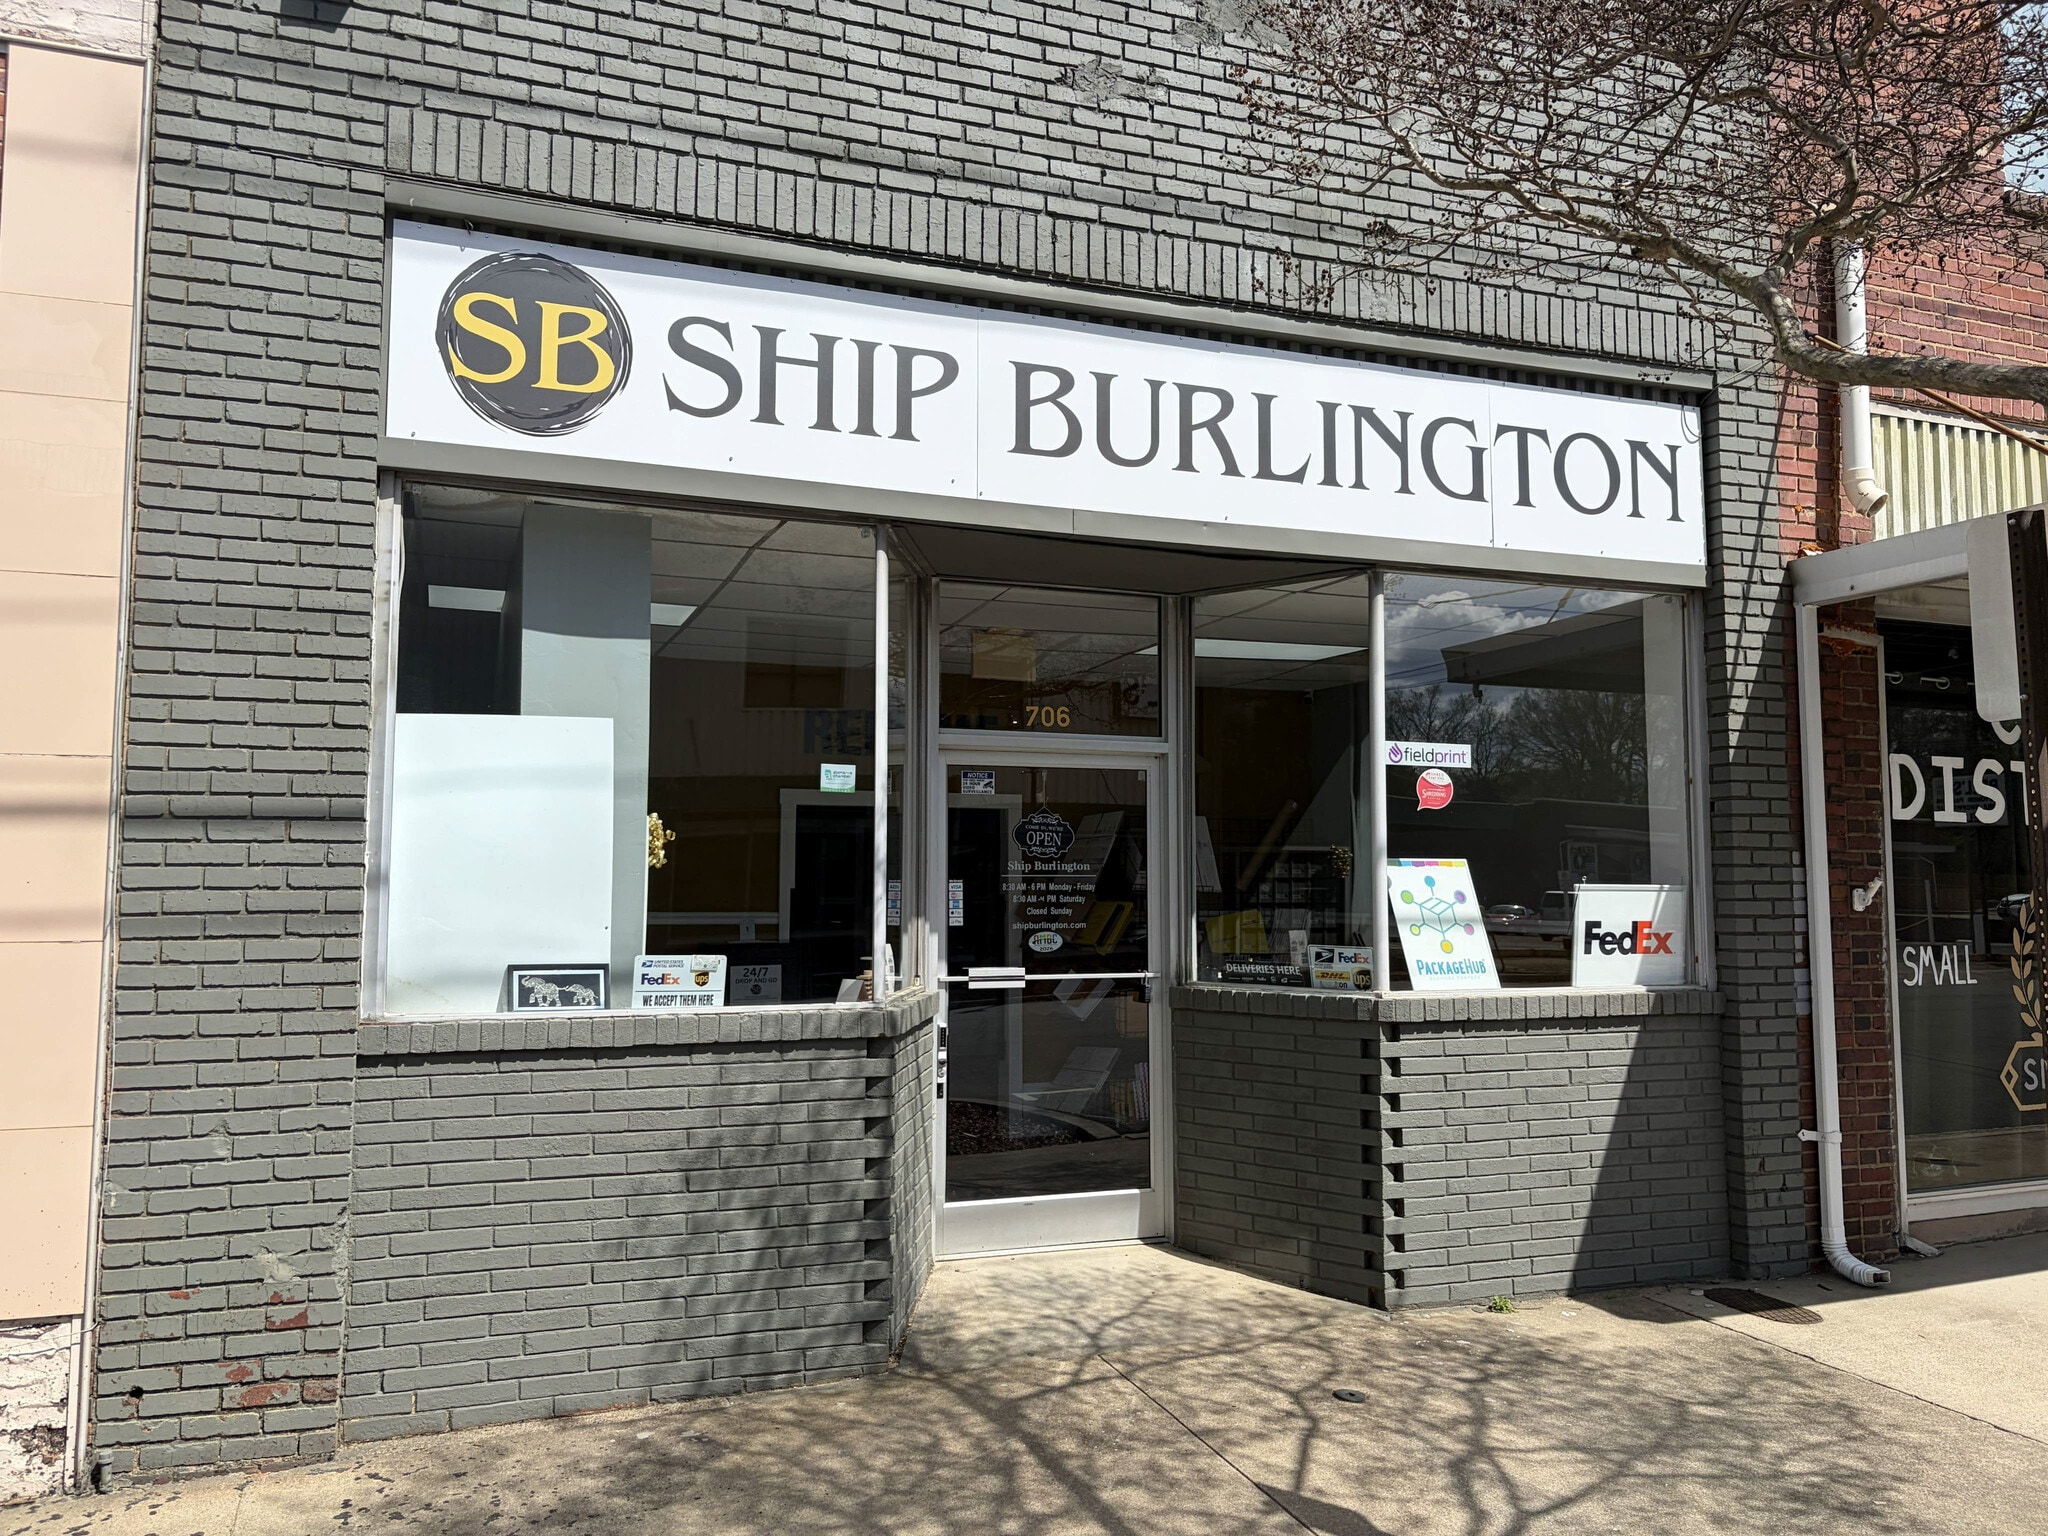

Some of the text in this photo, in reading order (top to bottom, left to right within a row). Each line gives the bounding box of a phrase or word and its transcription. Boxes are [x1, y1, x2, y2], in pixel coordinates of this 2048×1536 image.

[449, 291, 616, 394] SB
[662, 315, 1685, 523] SHIP BURLINGTON
[1026, 705, 1071, 728] 706
[1403, 746, 1467, 766] fieldprint
[1026, 830, 1062, 847] OPEN
[1007, 860, 1091, 873] Ship Burlington
[1002, 882, 1015, 891] 8:30
[1016, 883, 1027, 891] AM
[1031, 883, 1036, 891] 6
[1036, 883, 1046, 891] PM
[1048, 882, 1072, 893] Monday
[1077, 882, 1096, 893] Friday
[1012, 894, 1026, 903] 8:30
[1026, 895, 1037, 903] AM
[1046, 895, 1057, 903] PM
[1059, 894, 1086, 905] Saturday
[1026, 906, 1073, 916] Closed Sunday
[1012, 921, 1087, 931] shipburlington.com
[1584, 920, 1673, 956] FedEx
[1338, 951, 1370, 965] FedEx
[743, 967, 769, 978] 24/7
[1226, 963, 1275, 975] DELIVERIES
[1902, 945, 1978, 987] SMALL
[641, 973, 680, 986] FedEx
[695, 974, 709, 985] ups
[1320, 971, 1347, 980] DHL
[1353, 974, 1371, 989] ups
[642, 994, 714, 1007] WE ACCEPT THEM HERE
